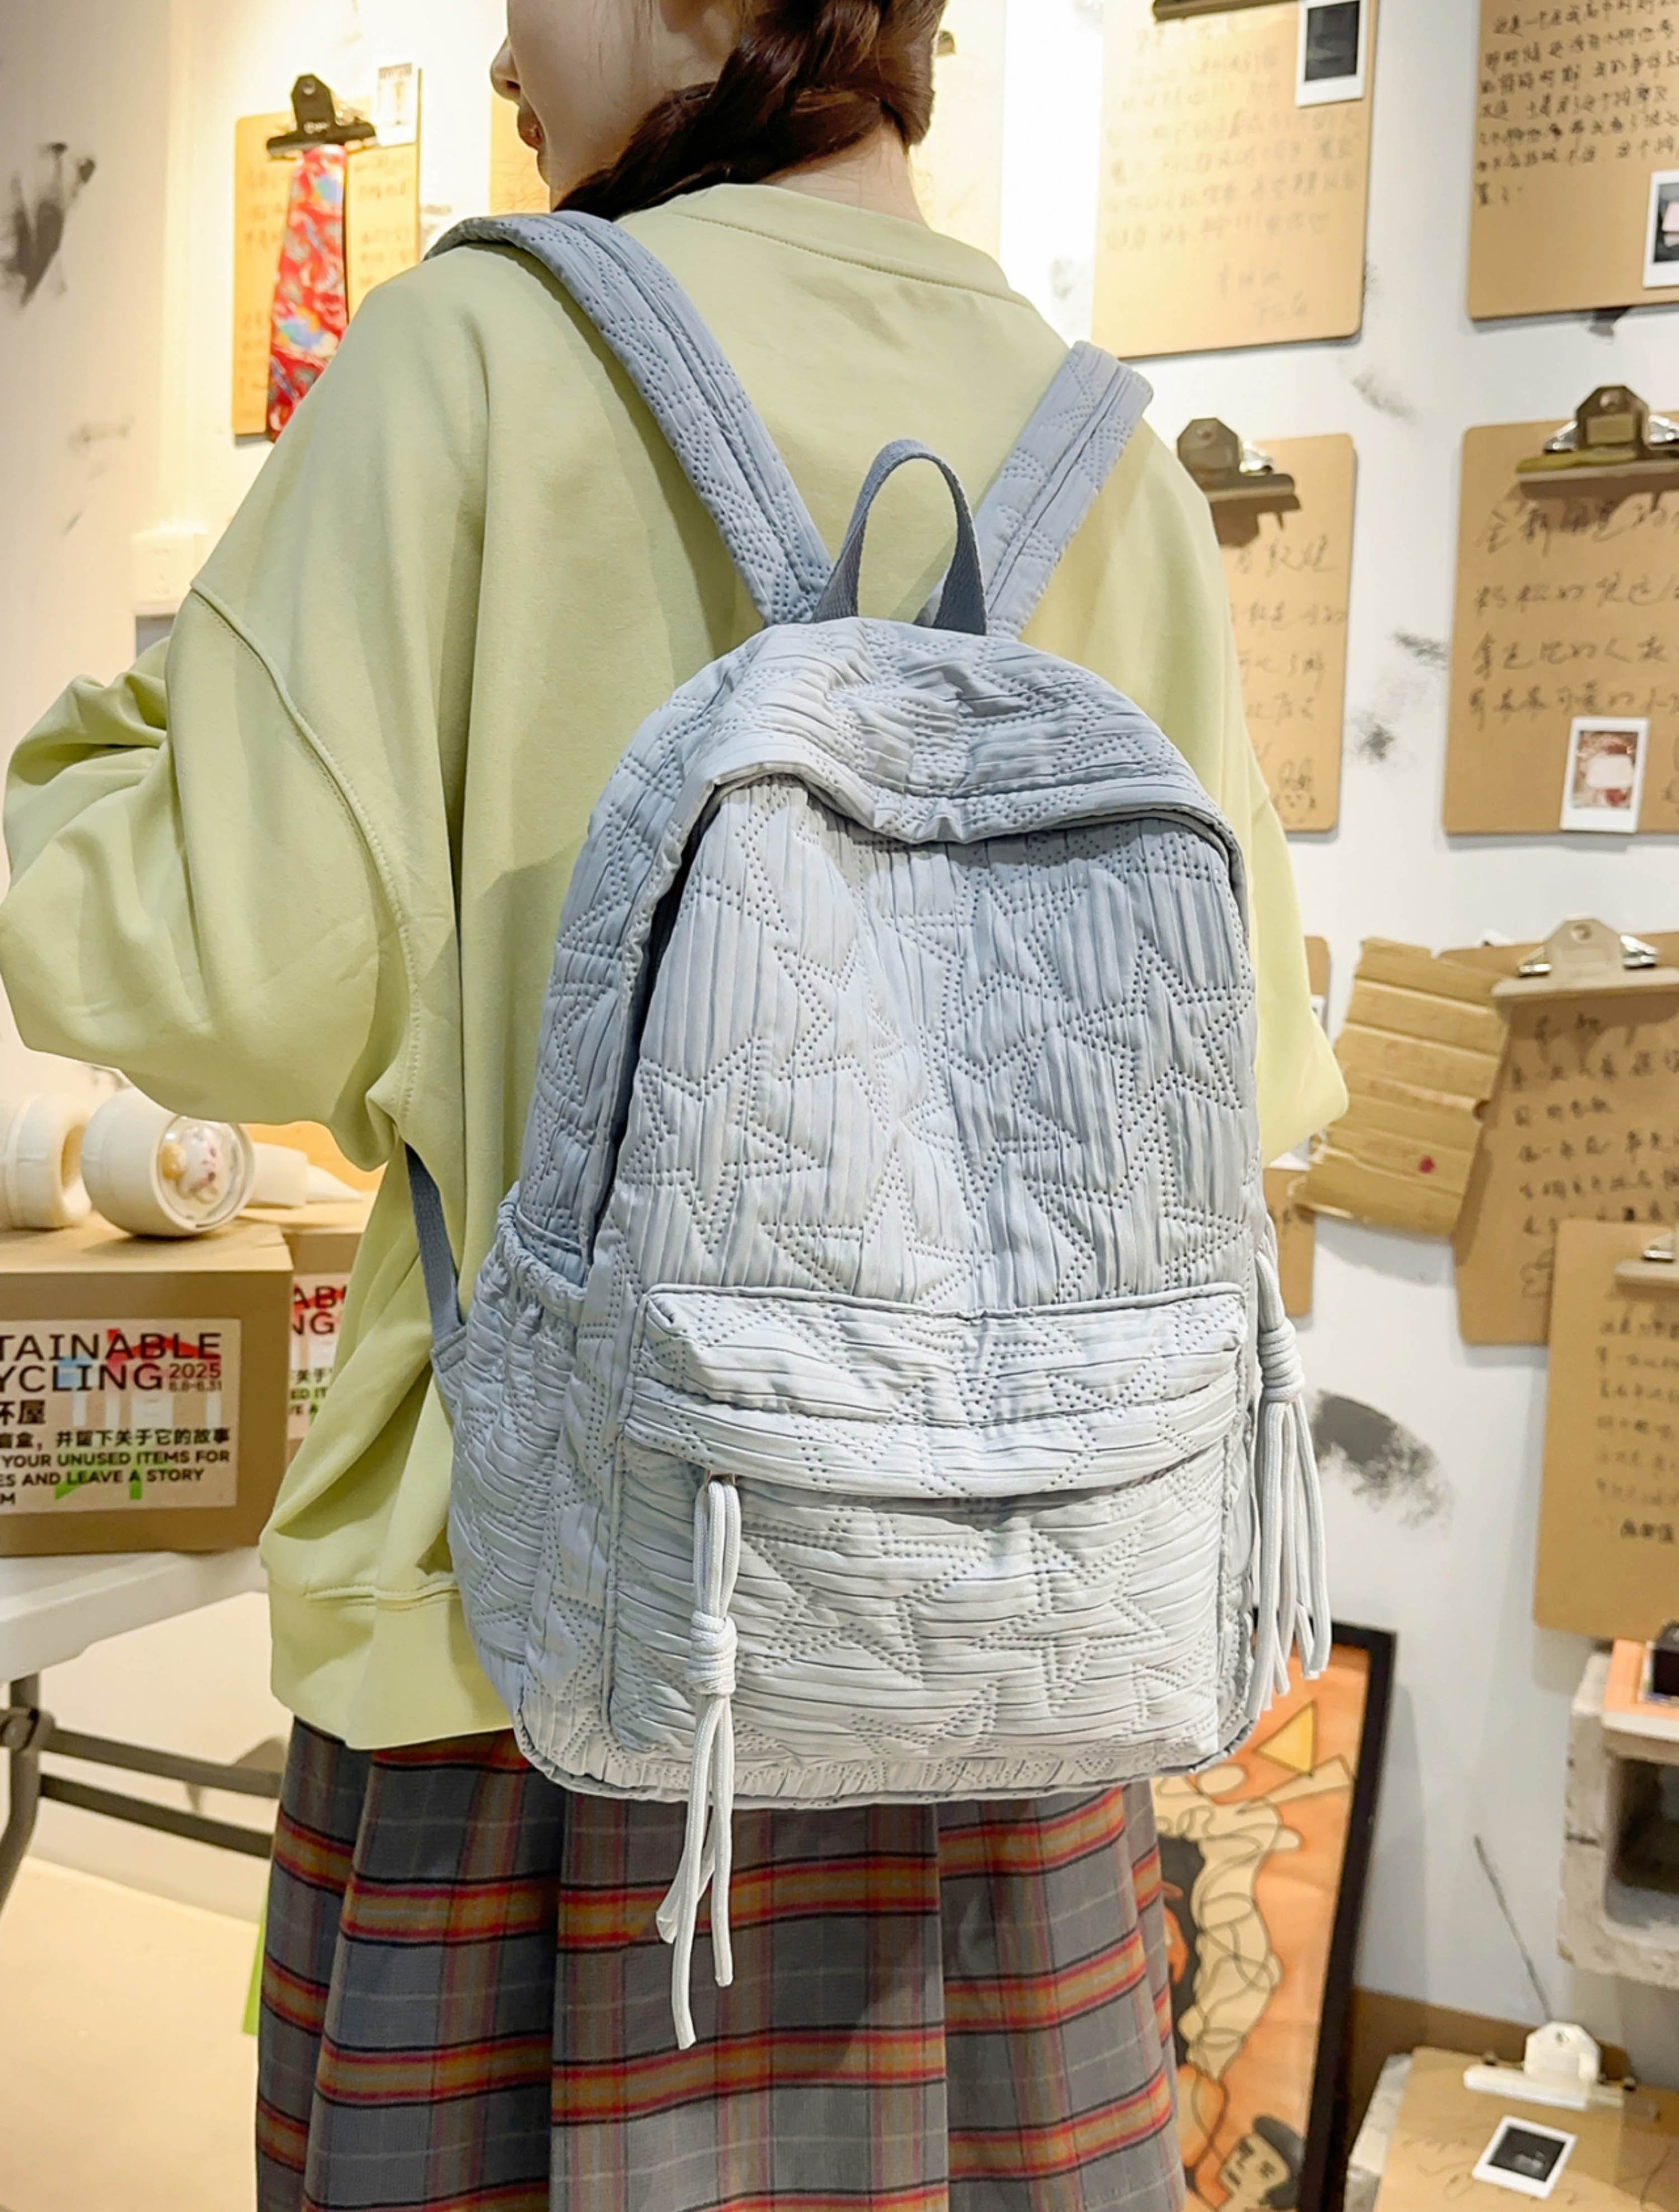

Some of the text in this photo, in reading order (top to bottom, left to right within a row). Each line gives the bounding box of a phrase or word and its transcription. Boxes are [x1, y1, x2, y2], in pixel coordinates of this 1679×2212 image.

[169, 1363, 221, 1379] 2025
[3, 1450, 230, 1468] YOUR UNUSED ITEMS FOR
[22, 1472, 61, 1486] AND
[66, 1470, 123, 1485] LEAVE
[129, 1469, 141, 1482] A
[147, 1468, 204, 1483] STORY
